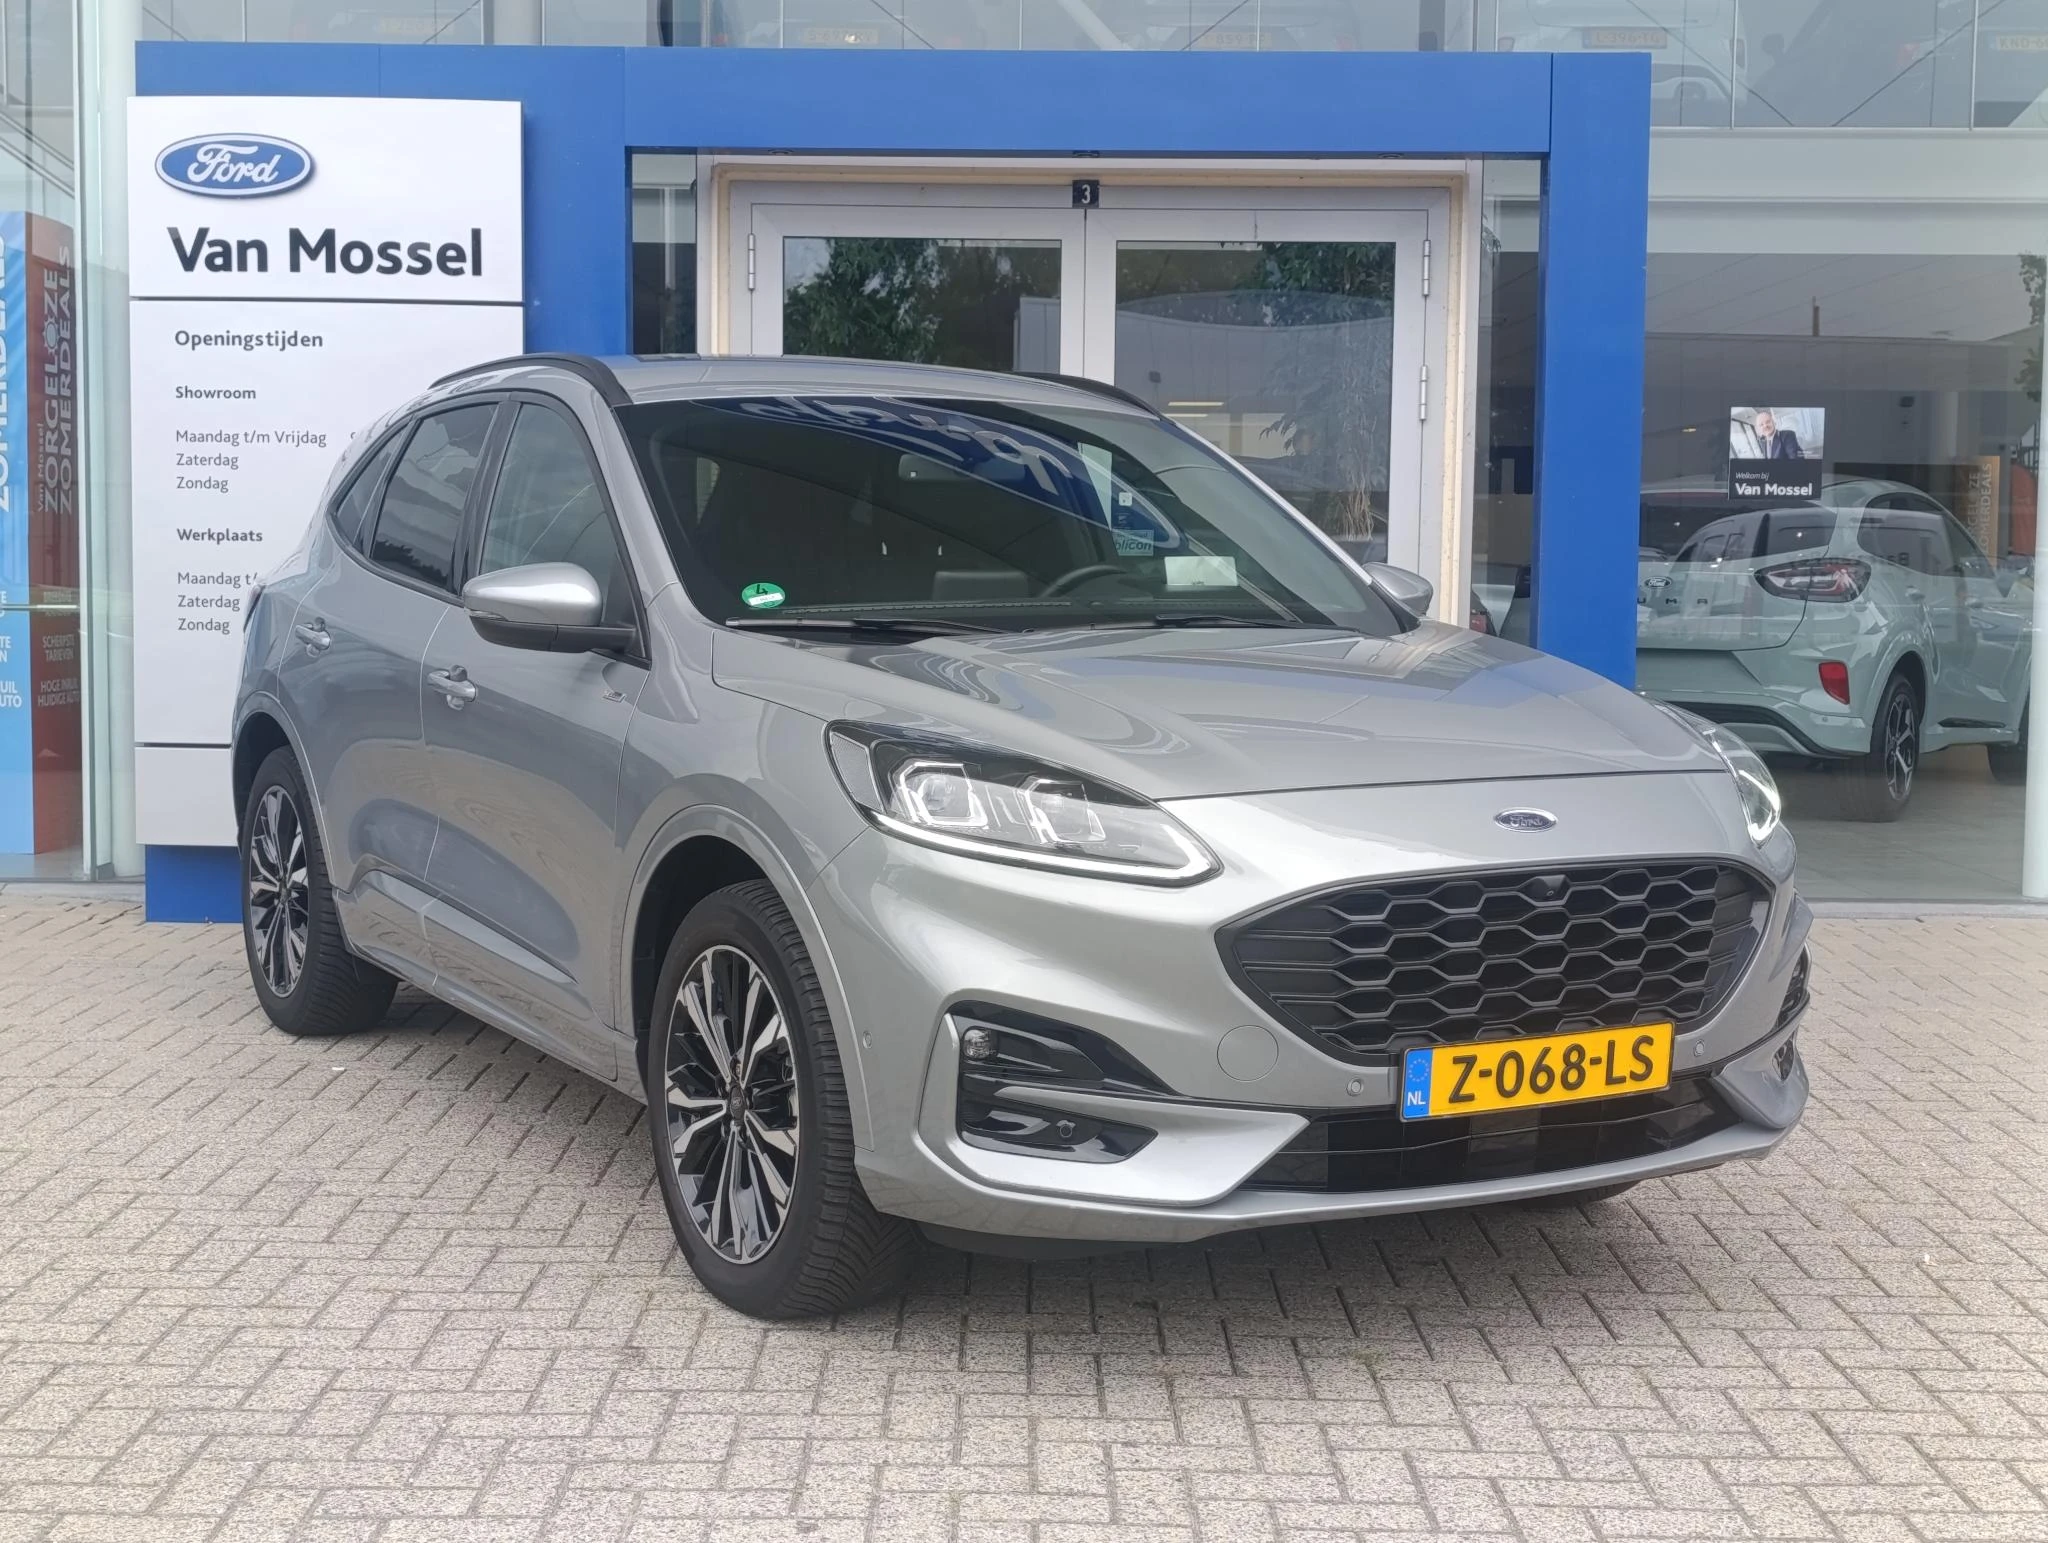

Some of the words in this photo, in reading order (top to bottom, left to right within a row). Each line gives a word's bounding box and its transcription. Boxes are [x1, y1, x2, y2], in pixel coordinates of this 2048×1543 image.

[187, 143, 280, 184] Ford
[1081, 183, 1091, 204] 3
[166, 226, 269, 273] Van
[288, 227, 482, 277] Mossel
[174, 329, 324, 351] Openingstijden
[59, 245, 72, 515] ZOMERDEALS
[175, 385, 257, 399] Showroom
[176, 429, 240, 447] Maandag
[243, 430, 270, 444] t/m
[274, 430, 327, 448] Vrijdag
[176, 453, 239, 470] Zaterdag
[176, 476, 229, 493] Zondag
[1735, 471, 1760, 480] Welkom
[1761, 472, 1770, 481] bij
[1735, 482, 1761, 495] Van
[1764, 482, 1813, 496] Mossel
[177, 528, 263, 545] Werkplaats
[177, 572, 241, 588] Maandag
[245, 572, 258, 585] t/
[756, 584, 768, 595] 4
[177, 595, 241, 612] Zaterdag
[177, 618, 231, 635] Zondag
[1448, 1035, 1655, 1104] Z-068-LS
[1407, 1091, 1426, 1106] NL
